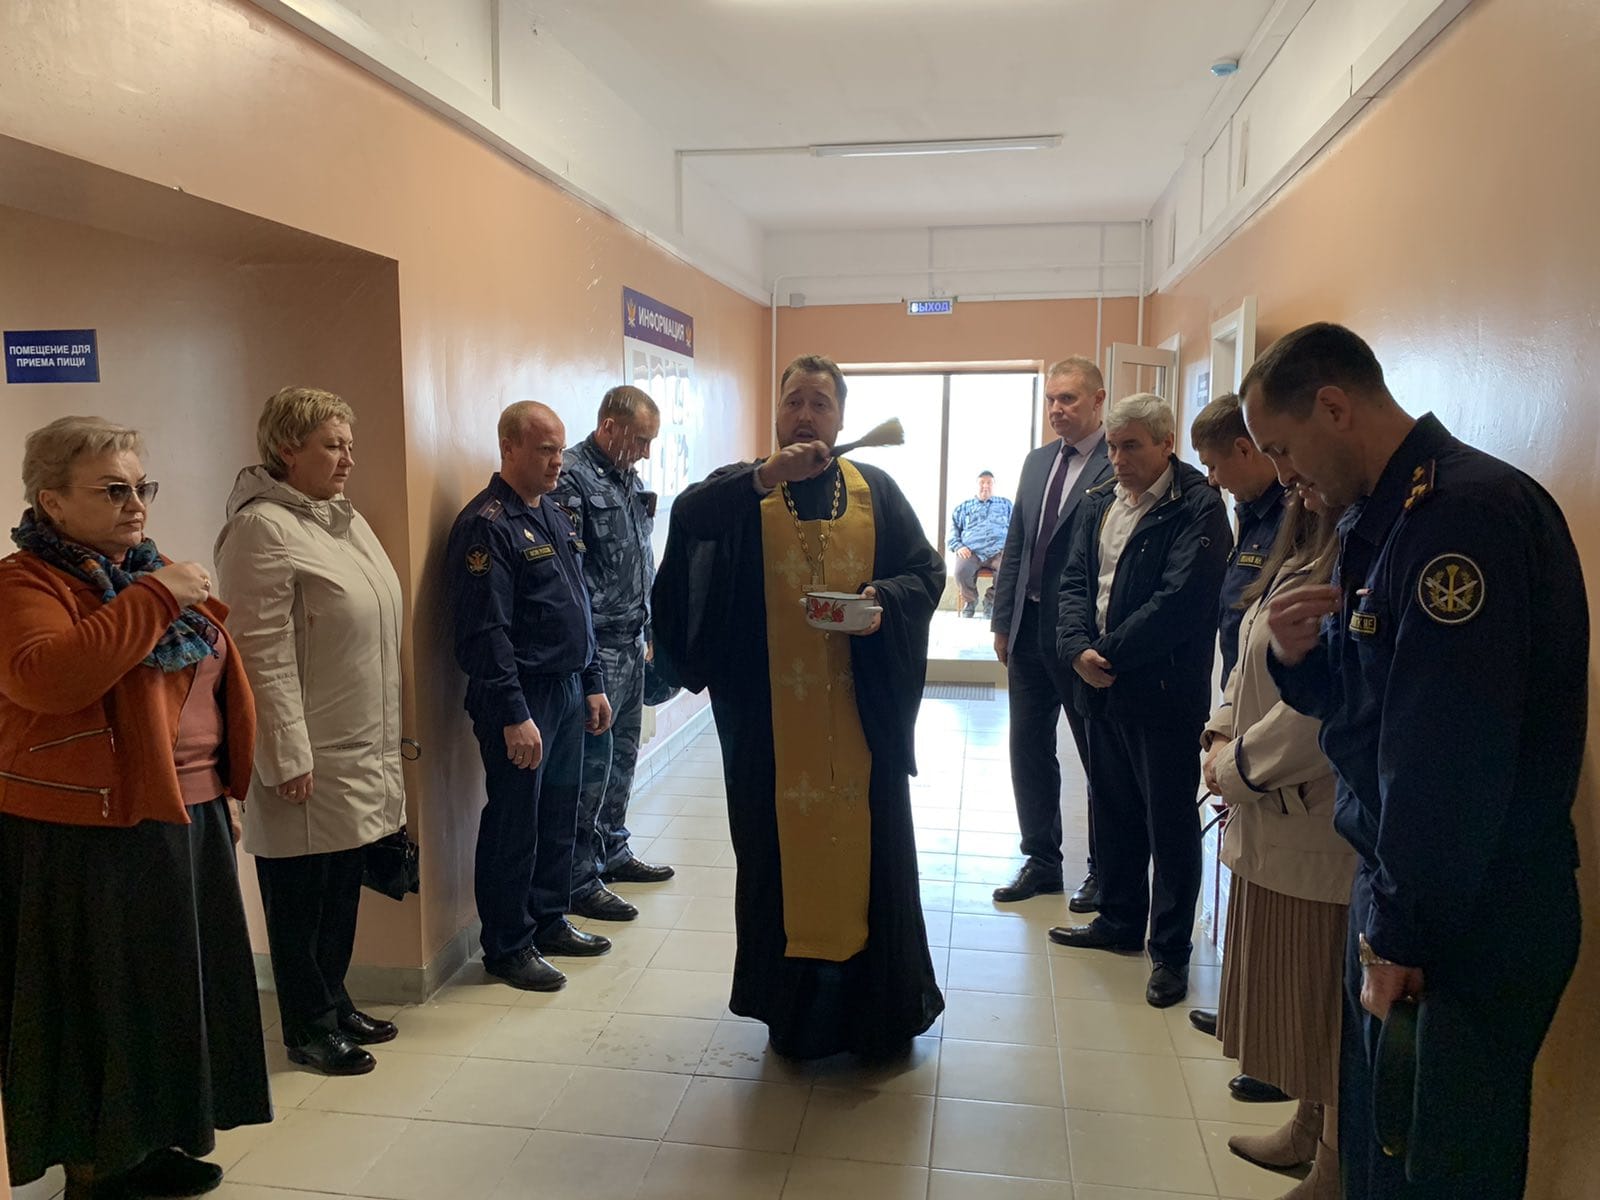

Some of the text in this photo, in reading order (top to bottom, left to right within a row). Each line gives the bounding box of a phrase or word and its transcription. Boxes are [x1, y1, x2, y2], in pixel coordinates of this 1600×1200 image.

[911, 302, 949, 313] ВЫХОД
[638, 305, 685, 342] ИНФОРМАЦИЯ
[9, 344, 91, 356] ПОМЕЩЕНИЕ ДЛЯ
[16, 357, 86, 368] ПРИЕМА ПИЩИ
